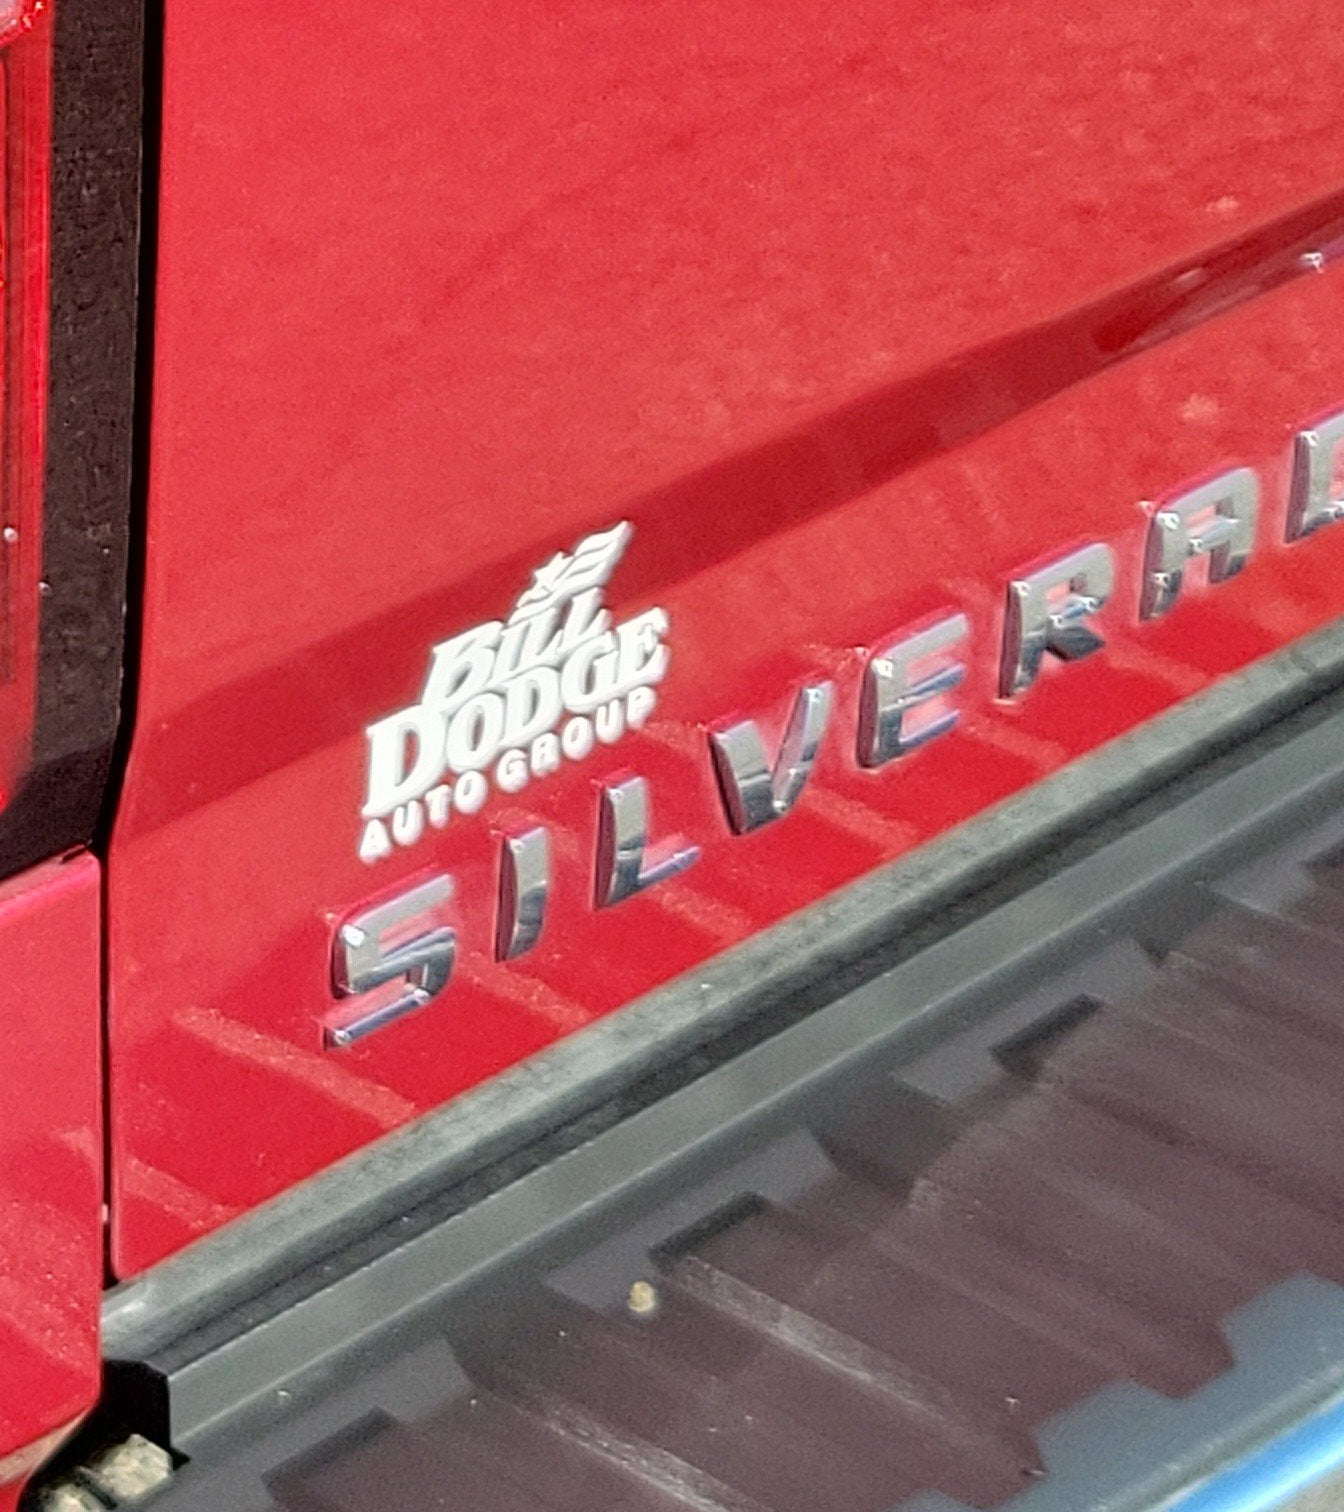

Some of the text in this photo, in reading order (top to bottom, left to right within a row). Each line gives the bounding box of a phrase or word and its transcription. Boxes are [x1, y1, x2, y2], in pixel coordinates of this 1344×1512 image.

[362, 607, 669, 817] DODGE
[421, 588, 611, 713] BILL
[359, 686, 656, 863] AUTO GROUP
